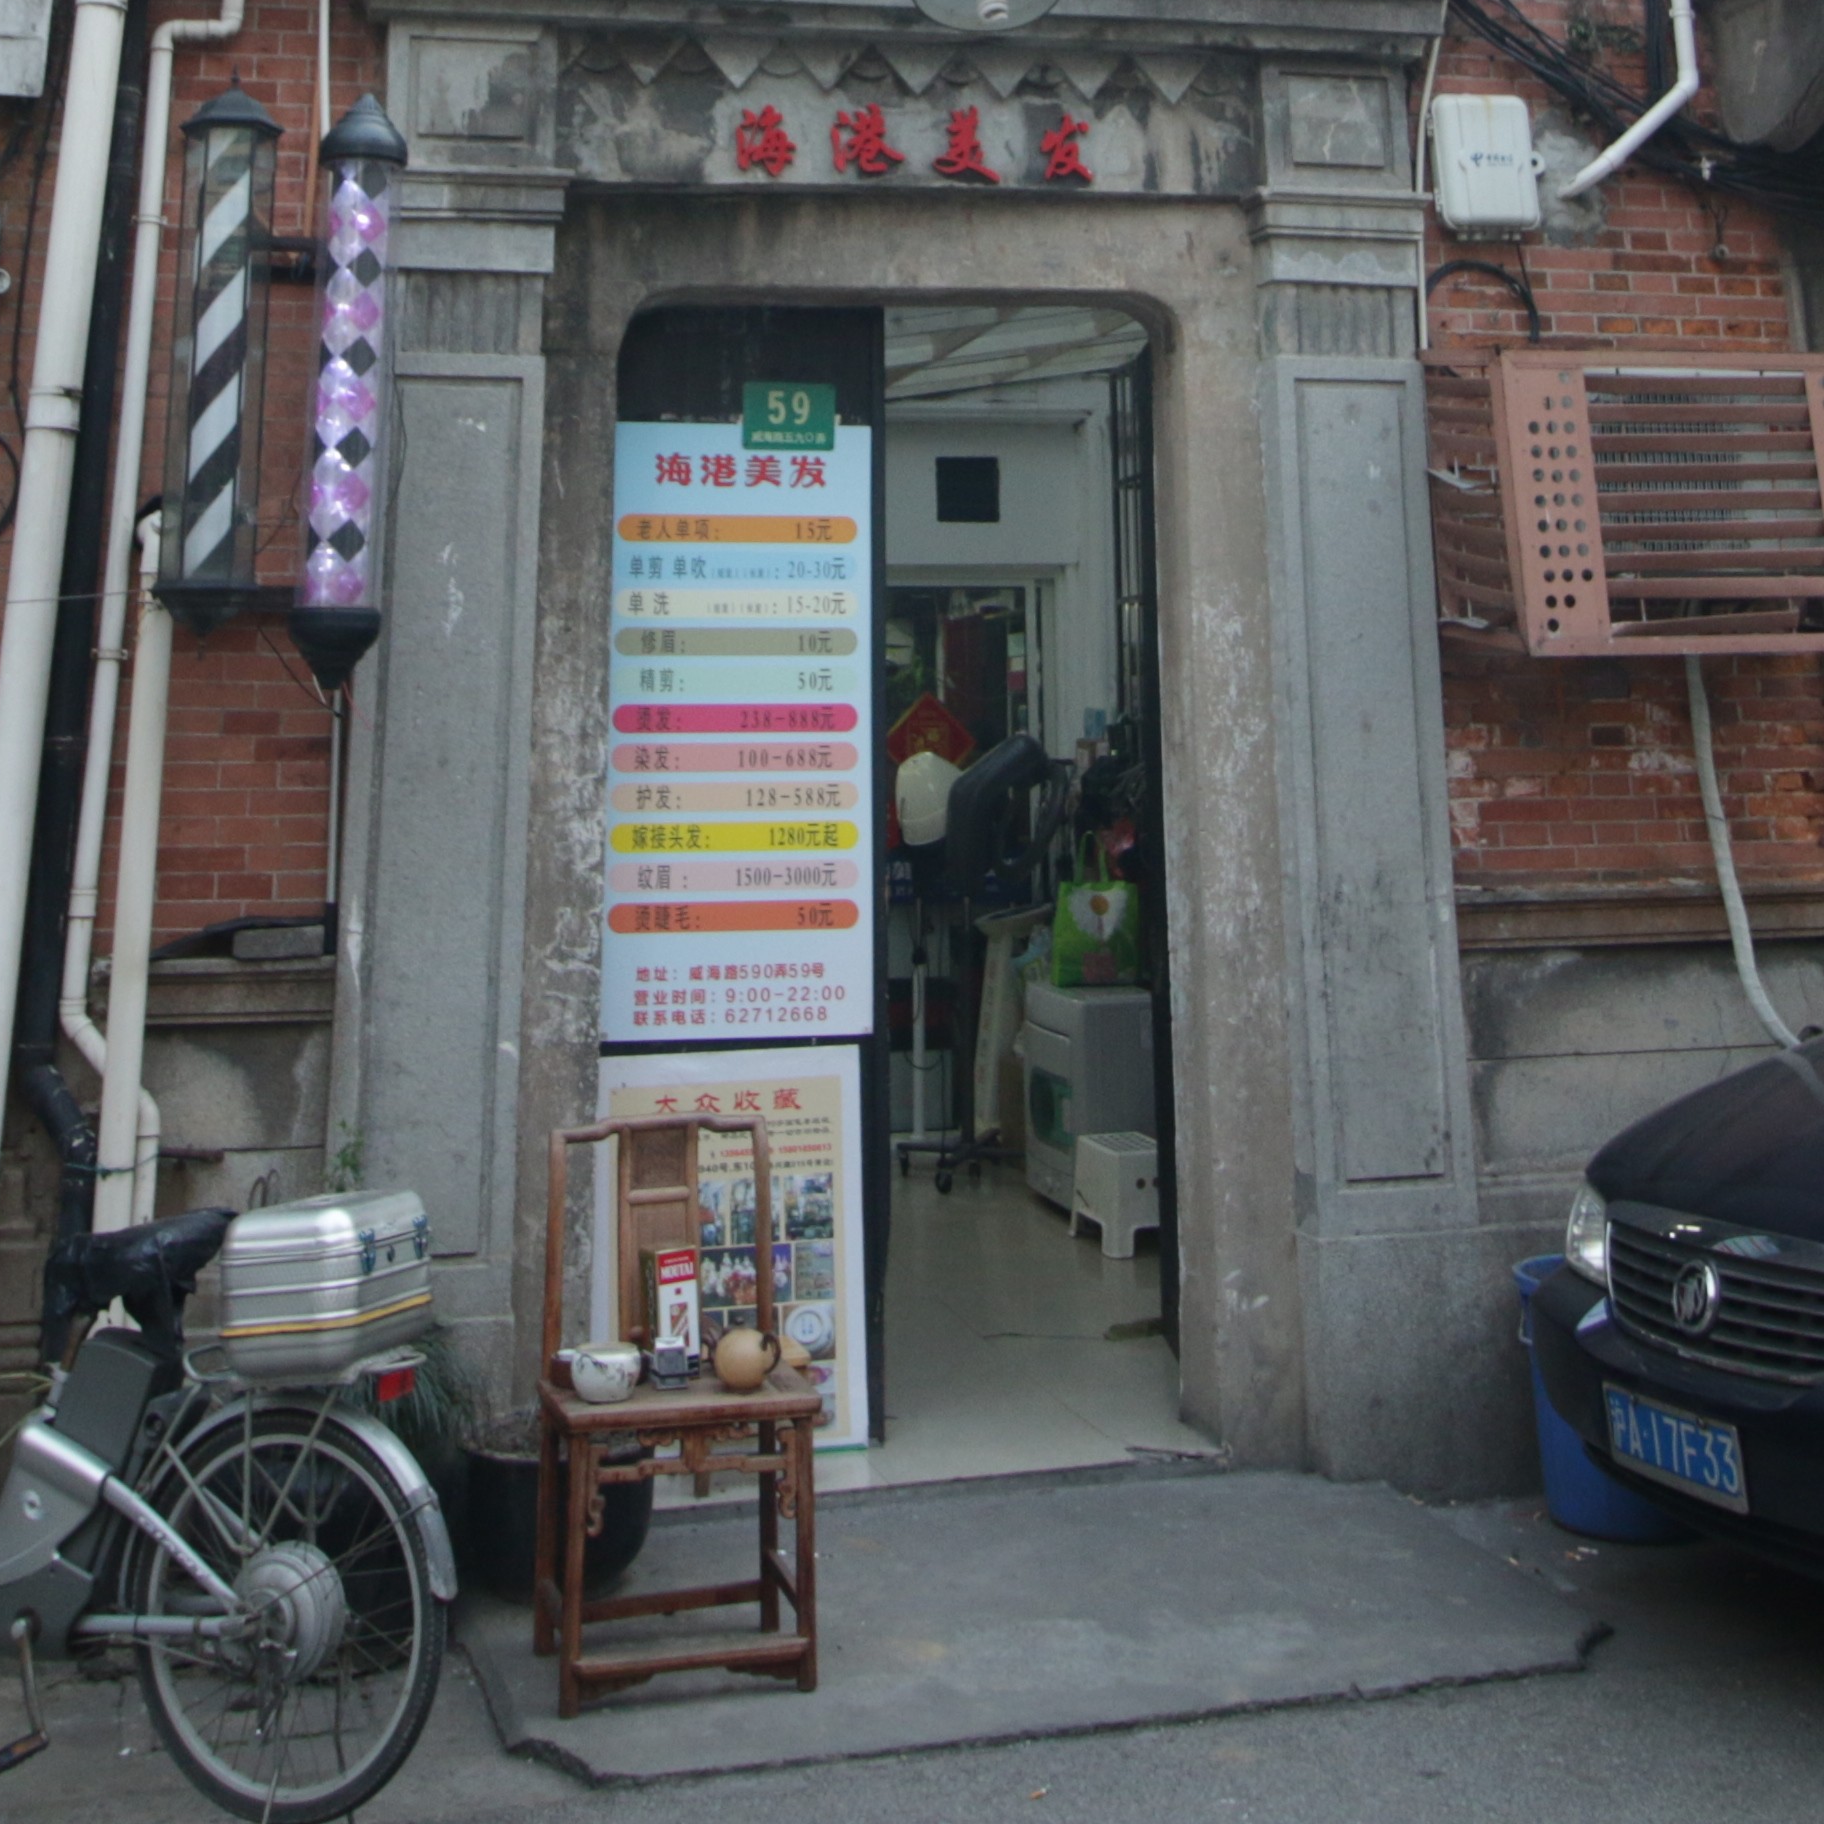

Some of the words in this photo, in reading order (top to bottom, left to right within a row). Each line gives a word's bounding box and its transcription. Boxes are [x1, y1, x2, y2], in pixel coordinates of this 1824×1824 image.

[735, 103, 1094, 184] 海港美发
[767, 390, 811, 425] 59
[654, 452, 827, 488] 海港美发
[795, 519, 833, 541] 15元
[798, 631, 833, 654] 10元
[797, 668, 833, 692] 50元
[768, 823, 840, 848] 1280元起
[797, 902, 835, 927] 50元
[654, 1088, 803, 1114] 大众收藏
